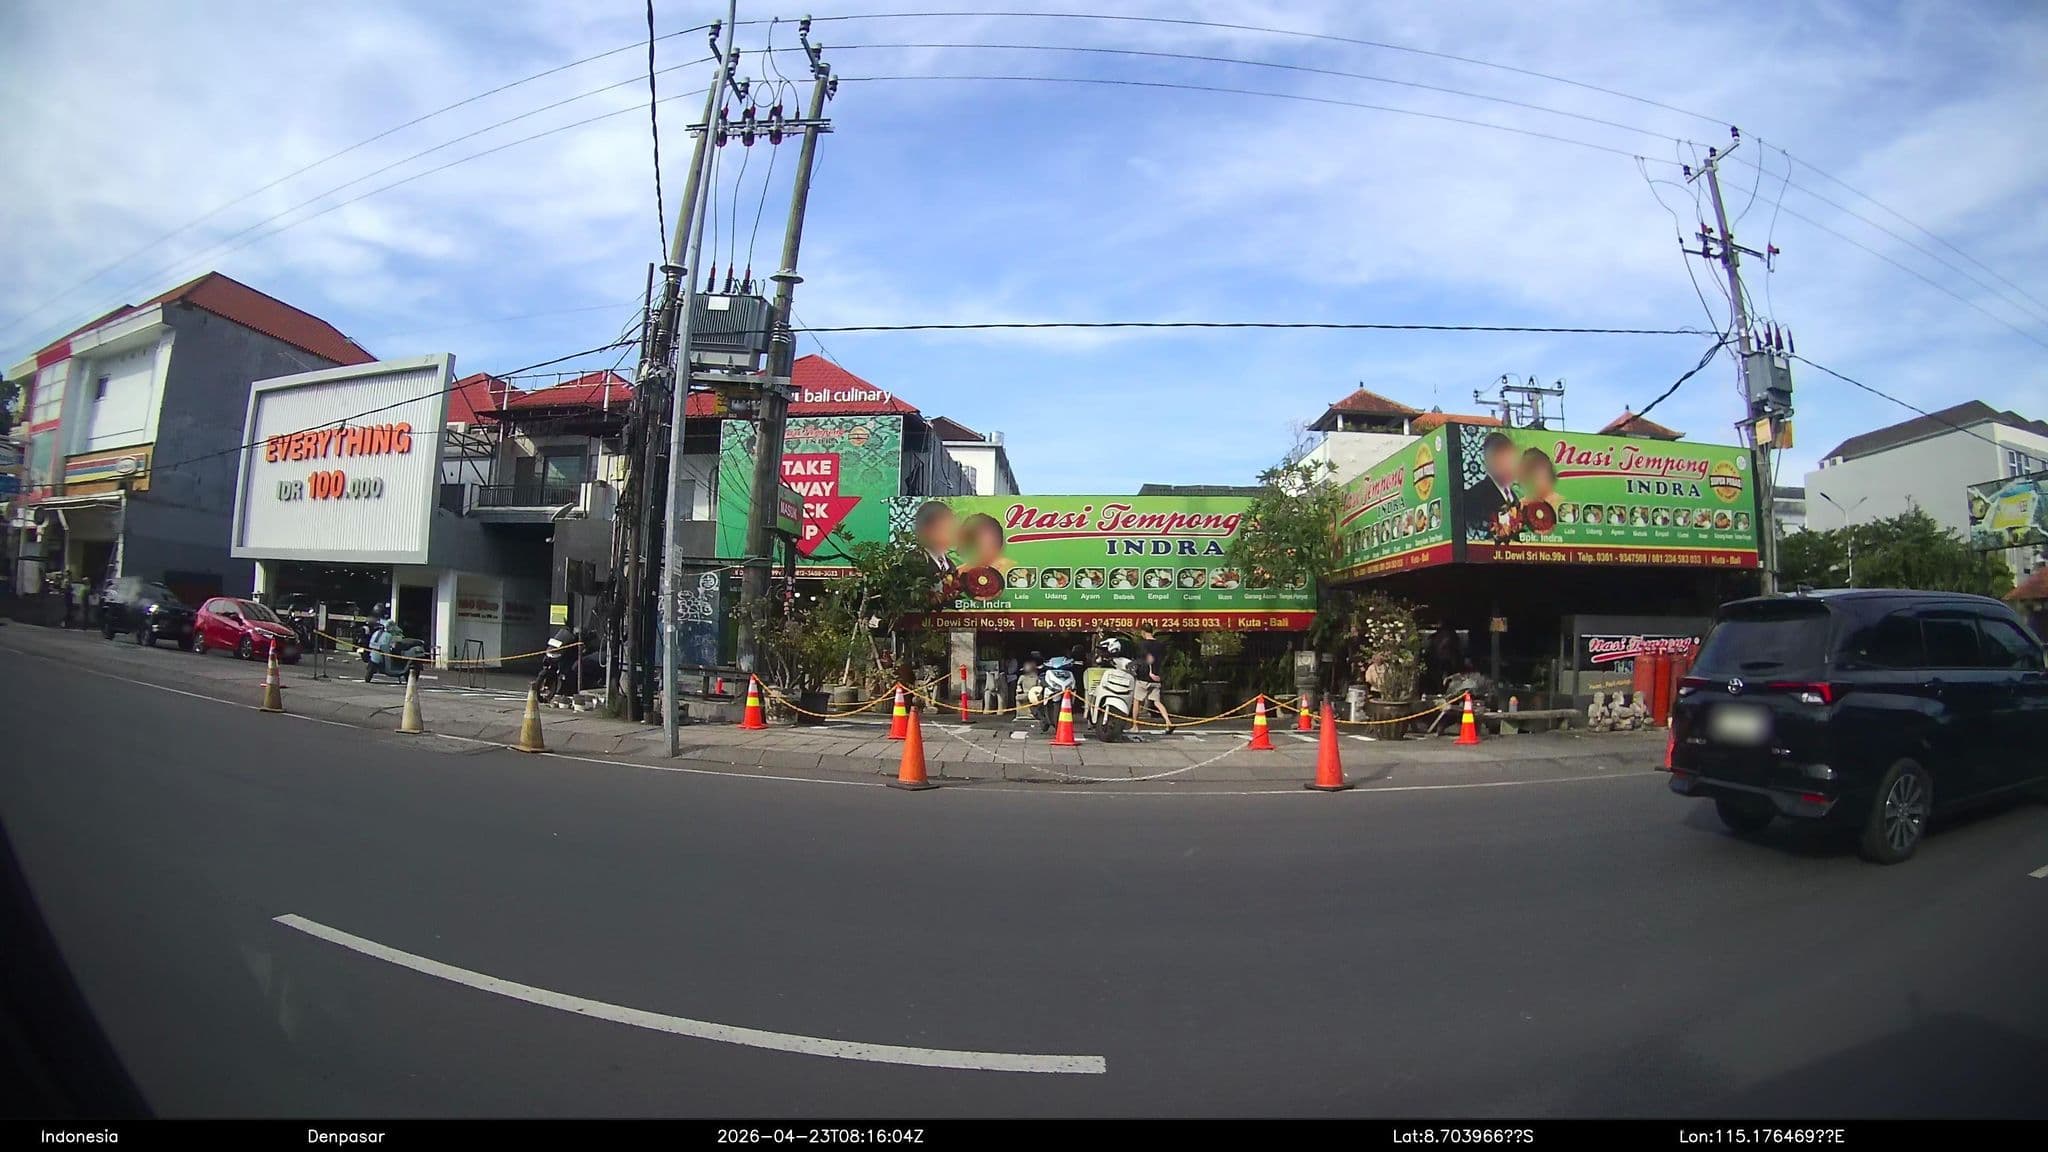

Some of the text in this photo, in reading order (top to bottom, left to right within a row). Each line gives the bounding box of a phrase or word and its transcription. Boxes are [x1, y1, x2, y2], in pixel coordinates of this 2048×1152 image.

[804, 388, 830, 402] bali
[833, 387, 892, 405] culinary
[265, 422, 412, 463] EVERYTHING
[782, 459, 832, 476] TAKE
[1554, 440, 1615, 467] Nasi
[1618, 445, 1710, 480] Tempong
[276, 479, 303, 501] IDR
[782, 481, 835, 497] WAY
[1626, 479, 1702, 498] INDRA
[1006, 503, 1242, 537] Nasi Tempong
[802, 525, 818, 540] P
[1106, 539, 1225, 556] INDRA
[1505, 550, 1525, 561] Dewi
[1526, 551, 1538, 561] Sri
[1577, 552, 1596, 563] Telp.
[955, 599, 1012, 611] Bpk. Indra
[1044, 592, 1067, 601] Udang
[1080, 593, 1101, 601] Ayam
[1147, 592, 1170, 601] Empal
[936, 617, 961, 628] Dewi
[963, 617, 978, 628] Sri
[980, 617, 1015, 628] No.99x
[1032, 617, 1056, 629] Telp.
[1059, 617, 1082, 628] 0361
[1162, 617, 1180, 628] 234
[1182, 617, 1200, 628] 583
[1202, 617, 1220, 628] 033
[1238, 617, 1262, 628] Kuta
[1269, 617, 1290, 628] Bali
[1589, 638, 1627, 653] Nasi
